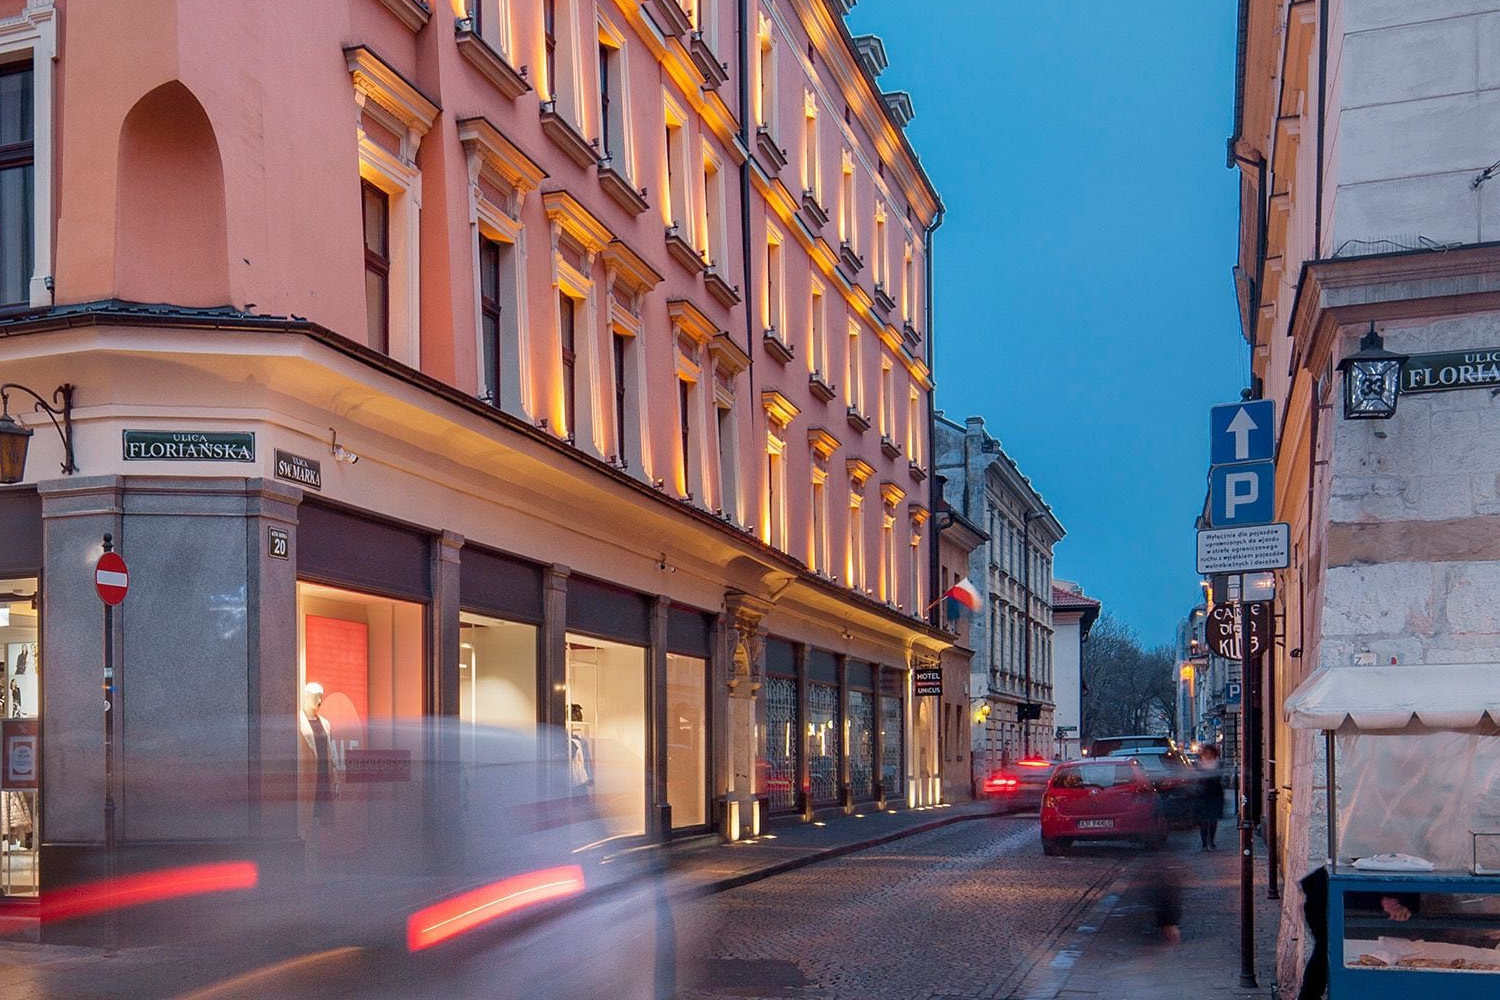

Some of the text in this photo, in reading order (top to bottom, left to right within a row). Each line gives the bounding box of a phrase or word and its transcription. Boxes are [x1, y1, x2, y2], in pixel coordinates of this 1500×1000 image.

[173, 434, 207, 442] ULICA
[129, 441, 250, 459] FLORIAŃSKA
[292, 456, 309, 467] ULICA
[1225, 472, 1259, 518] P
[274, 538, 286, 555] 20
[916, 672, 941, 680] HOTEL
[1230, 684, 1241, 698] P
